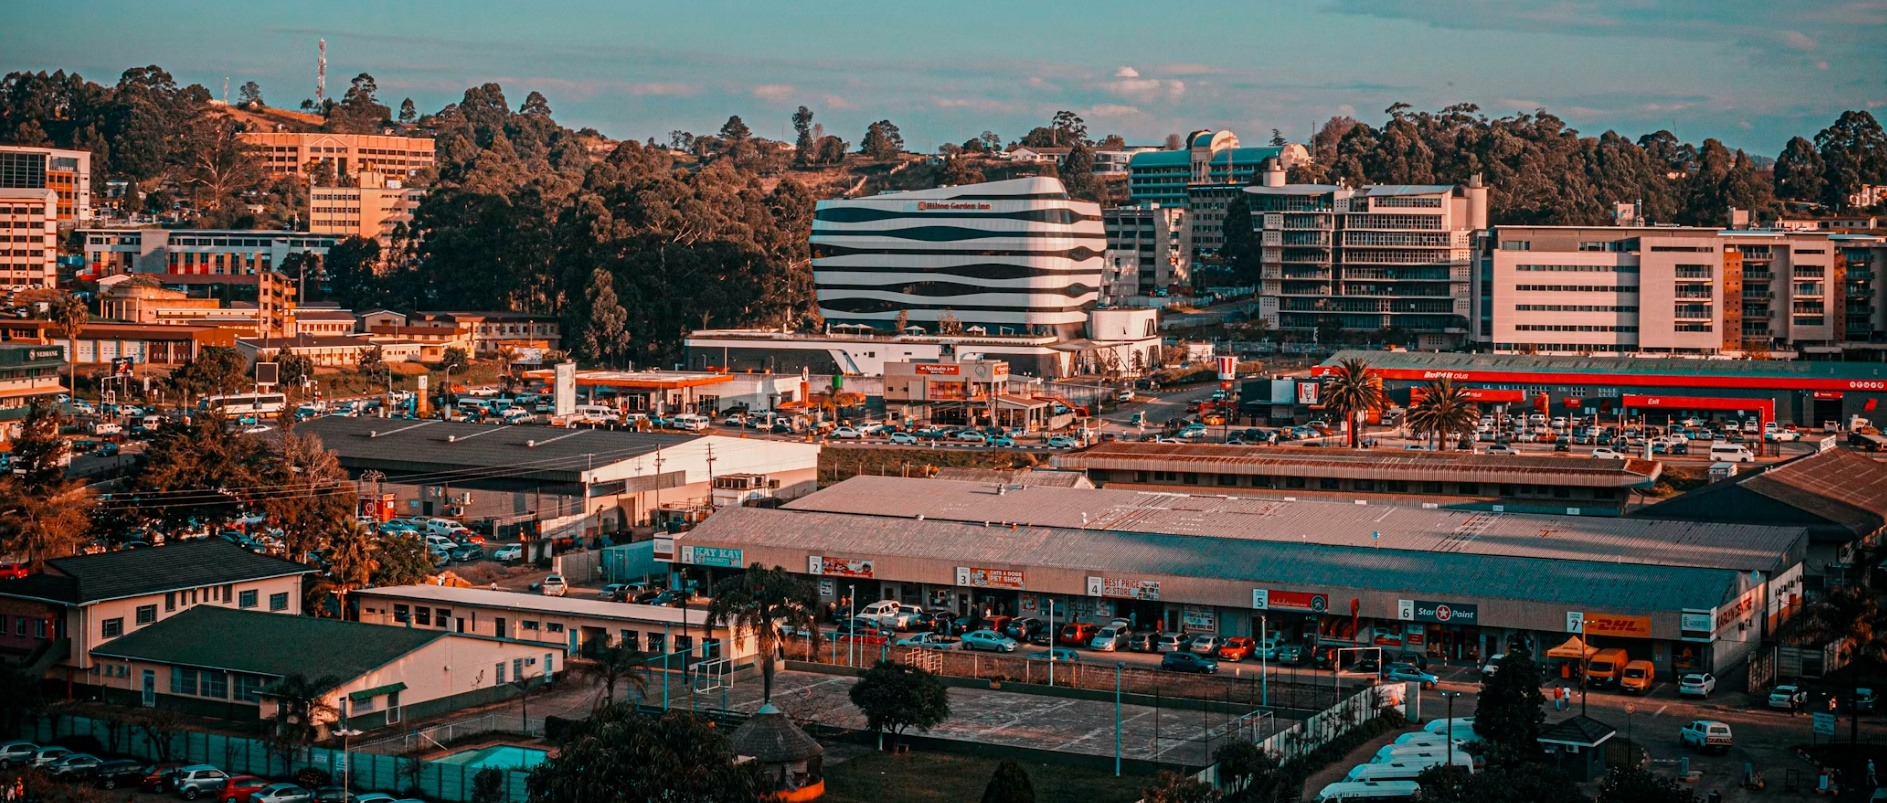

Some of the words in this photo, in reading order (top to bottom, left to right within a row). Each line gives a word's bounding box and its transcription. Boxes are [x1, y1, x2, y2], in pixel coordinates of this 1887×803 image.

[927, 202, 949, 210] Hilton
[950, 202, 976, 210] Garden
[978, 202, 991, 210] Inn
[1423, 371, 1445, 379] Build
[685, 553, 691, 562] 1
[695, 547, 718, 557] KAY
[719, 548, 741, 559] KAY
[813, 563, 818, 573] 2
[960, 575, 967, 585] 3
[1003, 576, 1022, 584] SHOP
[1104, 578, 1120, 587] BEST
[1121, 579, 1140, 589] PRICE
[1091, 585, 1099, 594] 4
[1112, 587, 1132, 596] STORE
[1257, 598, 1264, 607] 5
[1402, 608, 1409, 618] 6
[1418, 607, 1435, 616] Star
[1452, 610, 1474, 618] Paint
[1571, 619, 1578, 631] 7
[1597, 618, 1638, 632] DHL
